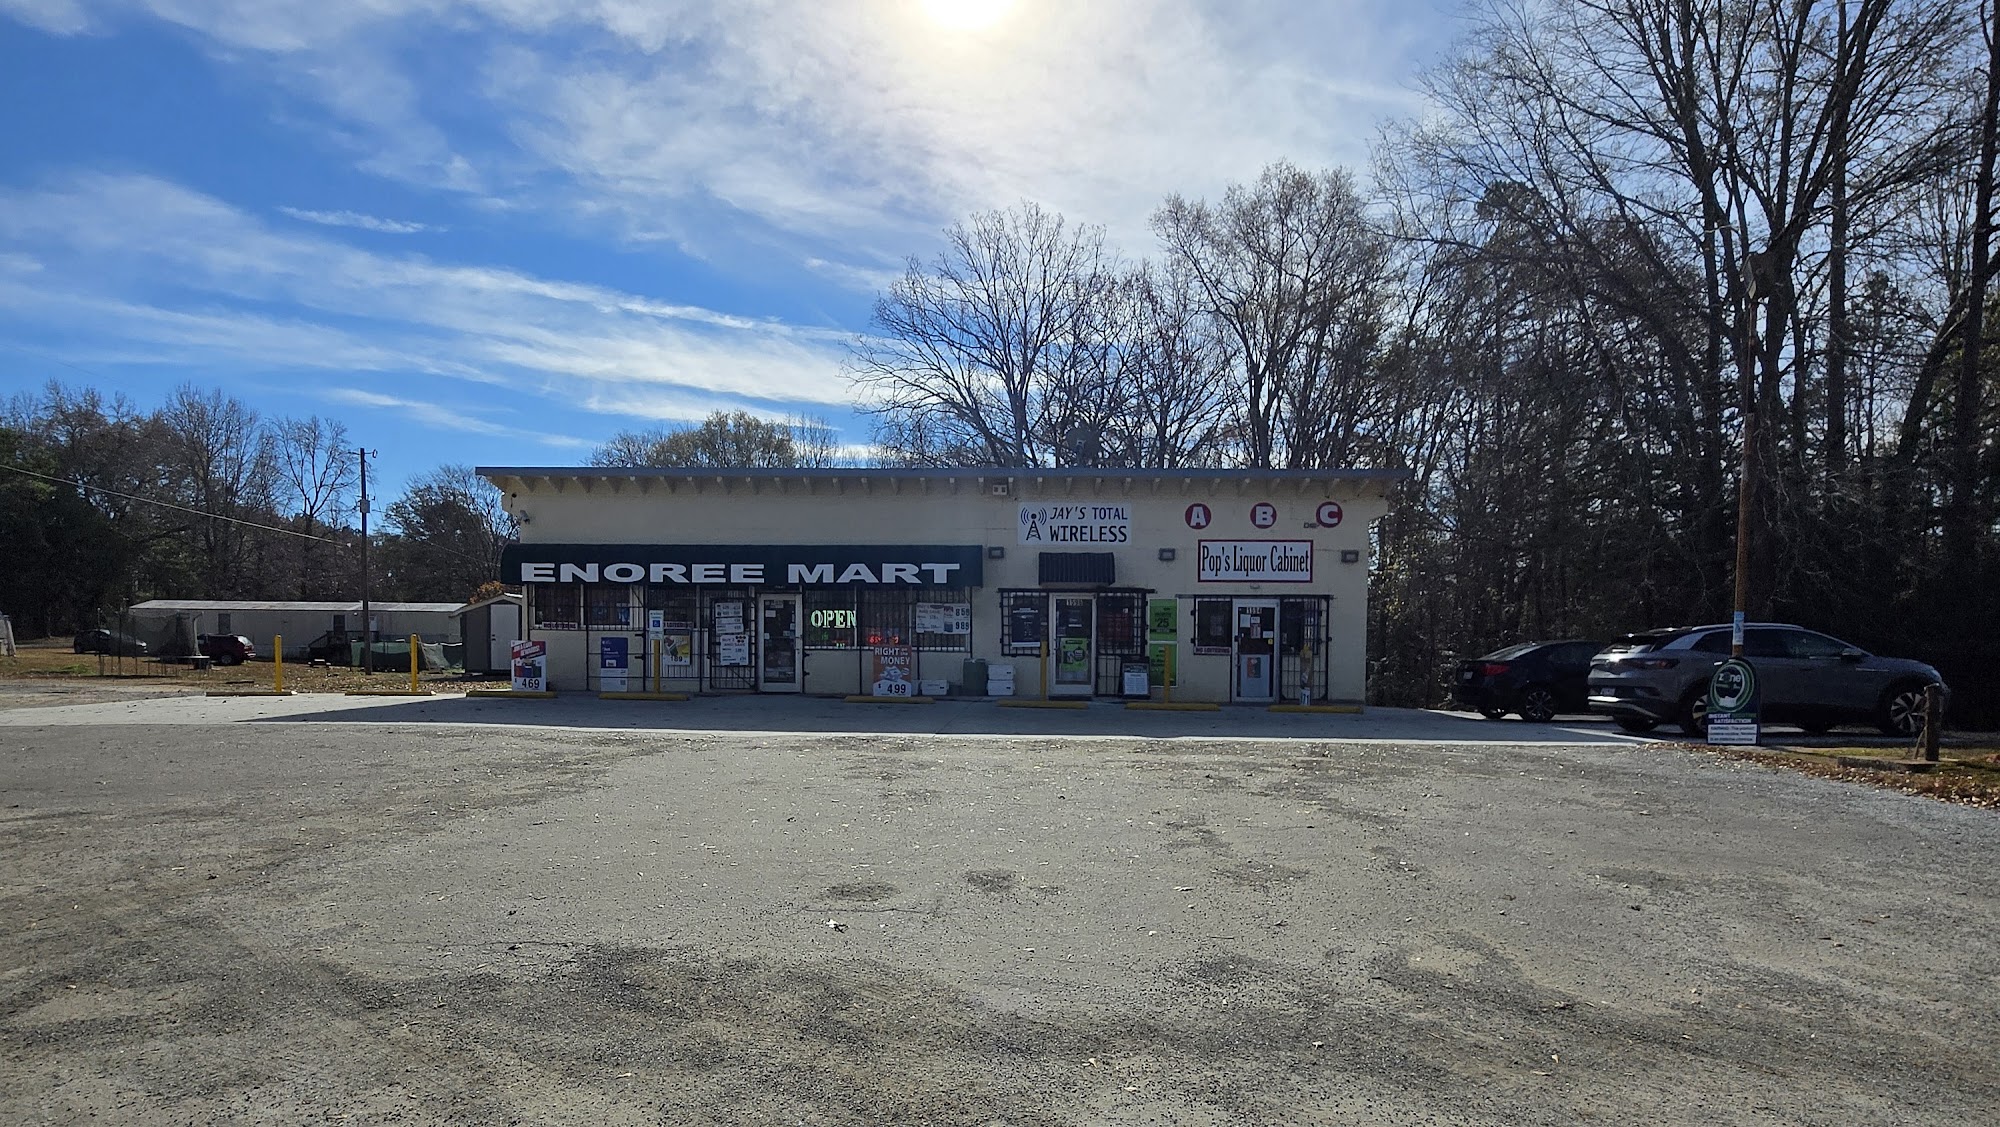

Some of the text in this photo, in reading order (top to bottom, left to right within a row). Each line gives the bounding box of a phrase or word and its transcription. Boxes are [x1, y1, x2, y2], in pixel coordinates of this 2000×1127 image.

[1050, 506, 1128, 520] JAY'S TOTAL
[1190, 504, 1338, 526] A B C
[1050, 526, 1128, 542] WIRELESS
[1202, 545, 1309, 576] Pop's Liquor Cabinet
[521, 562, 960, 584] ENOREE MART
[810, 609, 857, 628] OPEN
[874, 647, 900, 656] RIGHT
[880, 657, 910, 665] MONEY
